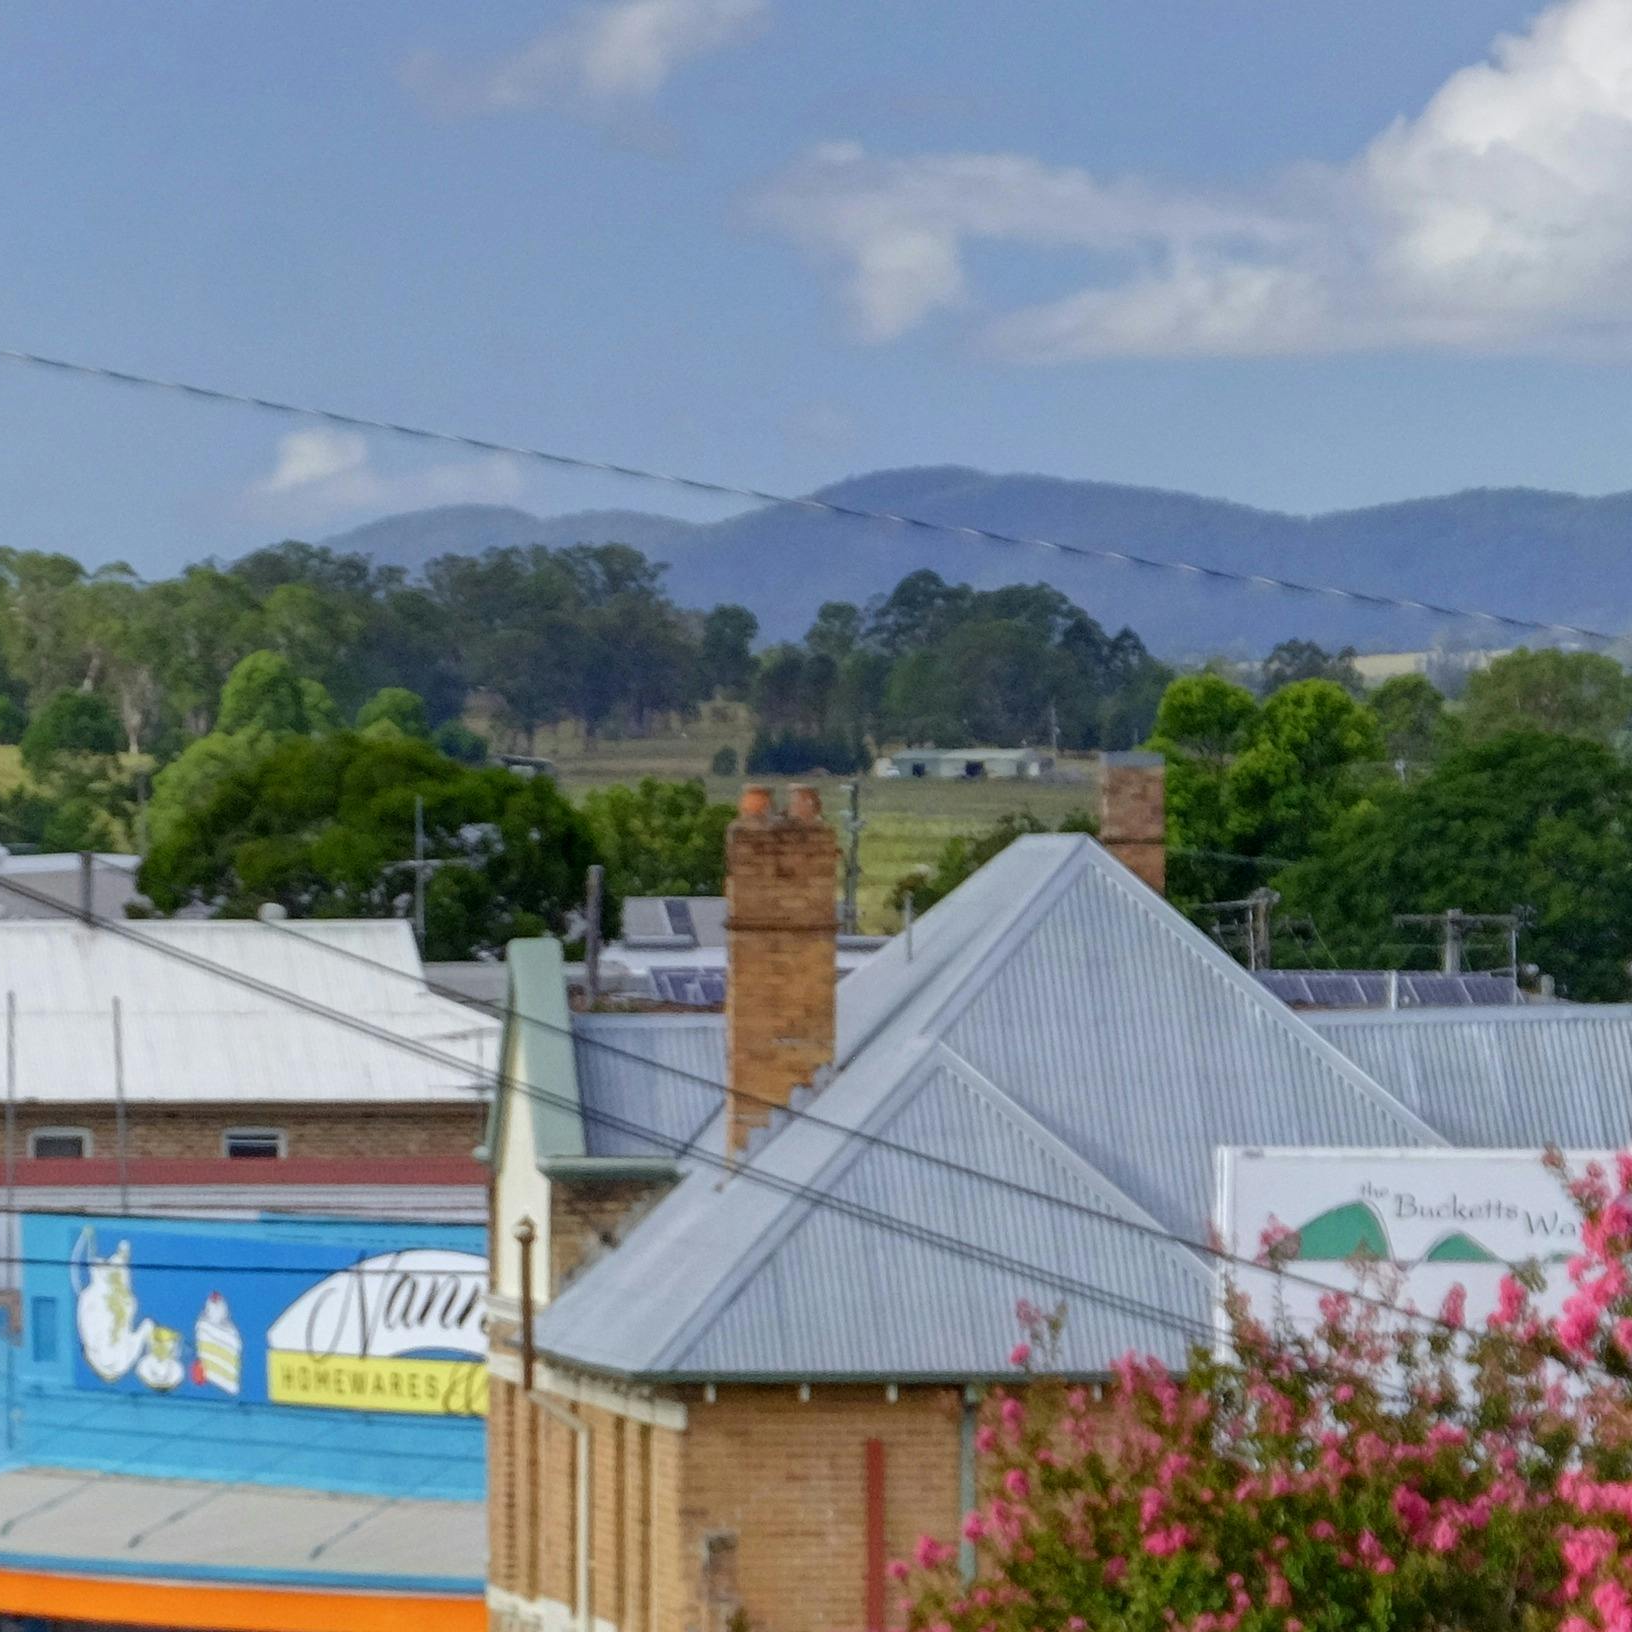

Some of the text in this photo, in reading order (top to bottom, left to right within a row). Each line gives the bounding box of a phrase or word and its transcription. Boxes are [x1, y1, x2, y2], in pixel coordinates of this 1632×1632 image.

[1360, 1181, 1584, 1237] the Bucketts Wa
[282, 1364, 440, 1401] HOMEWARES
